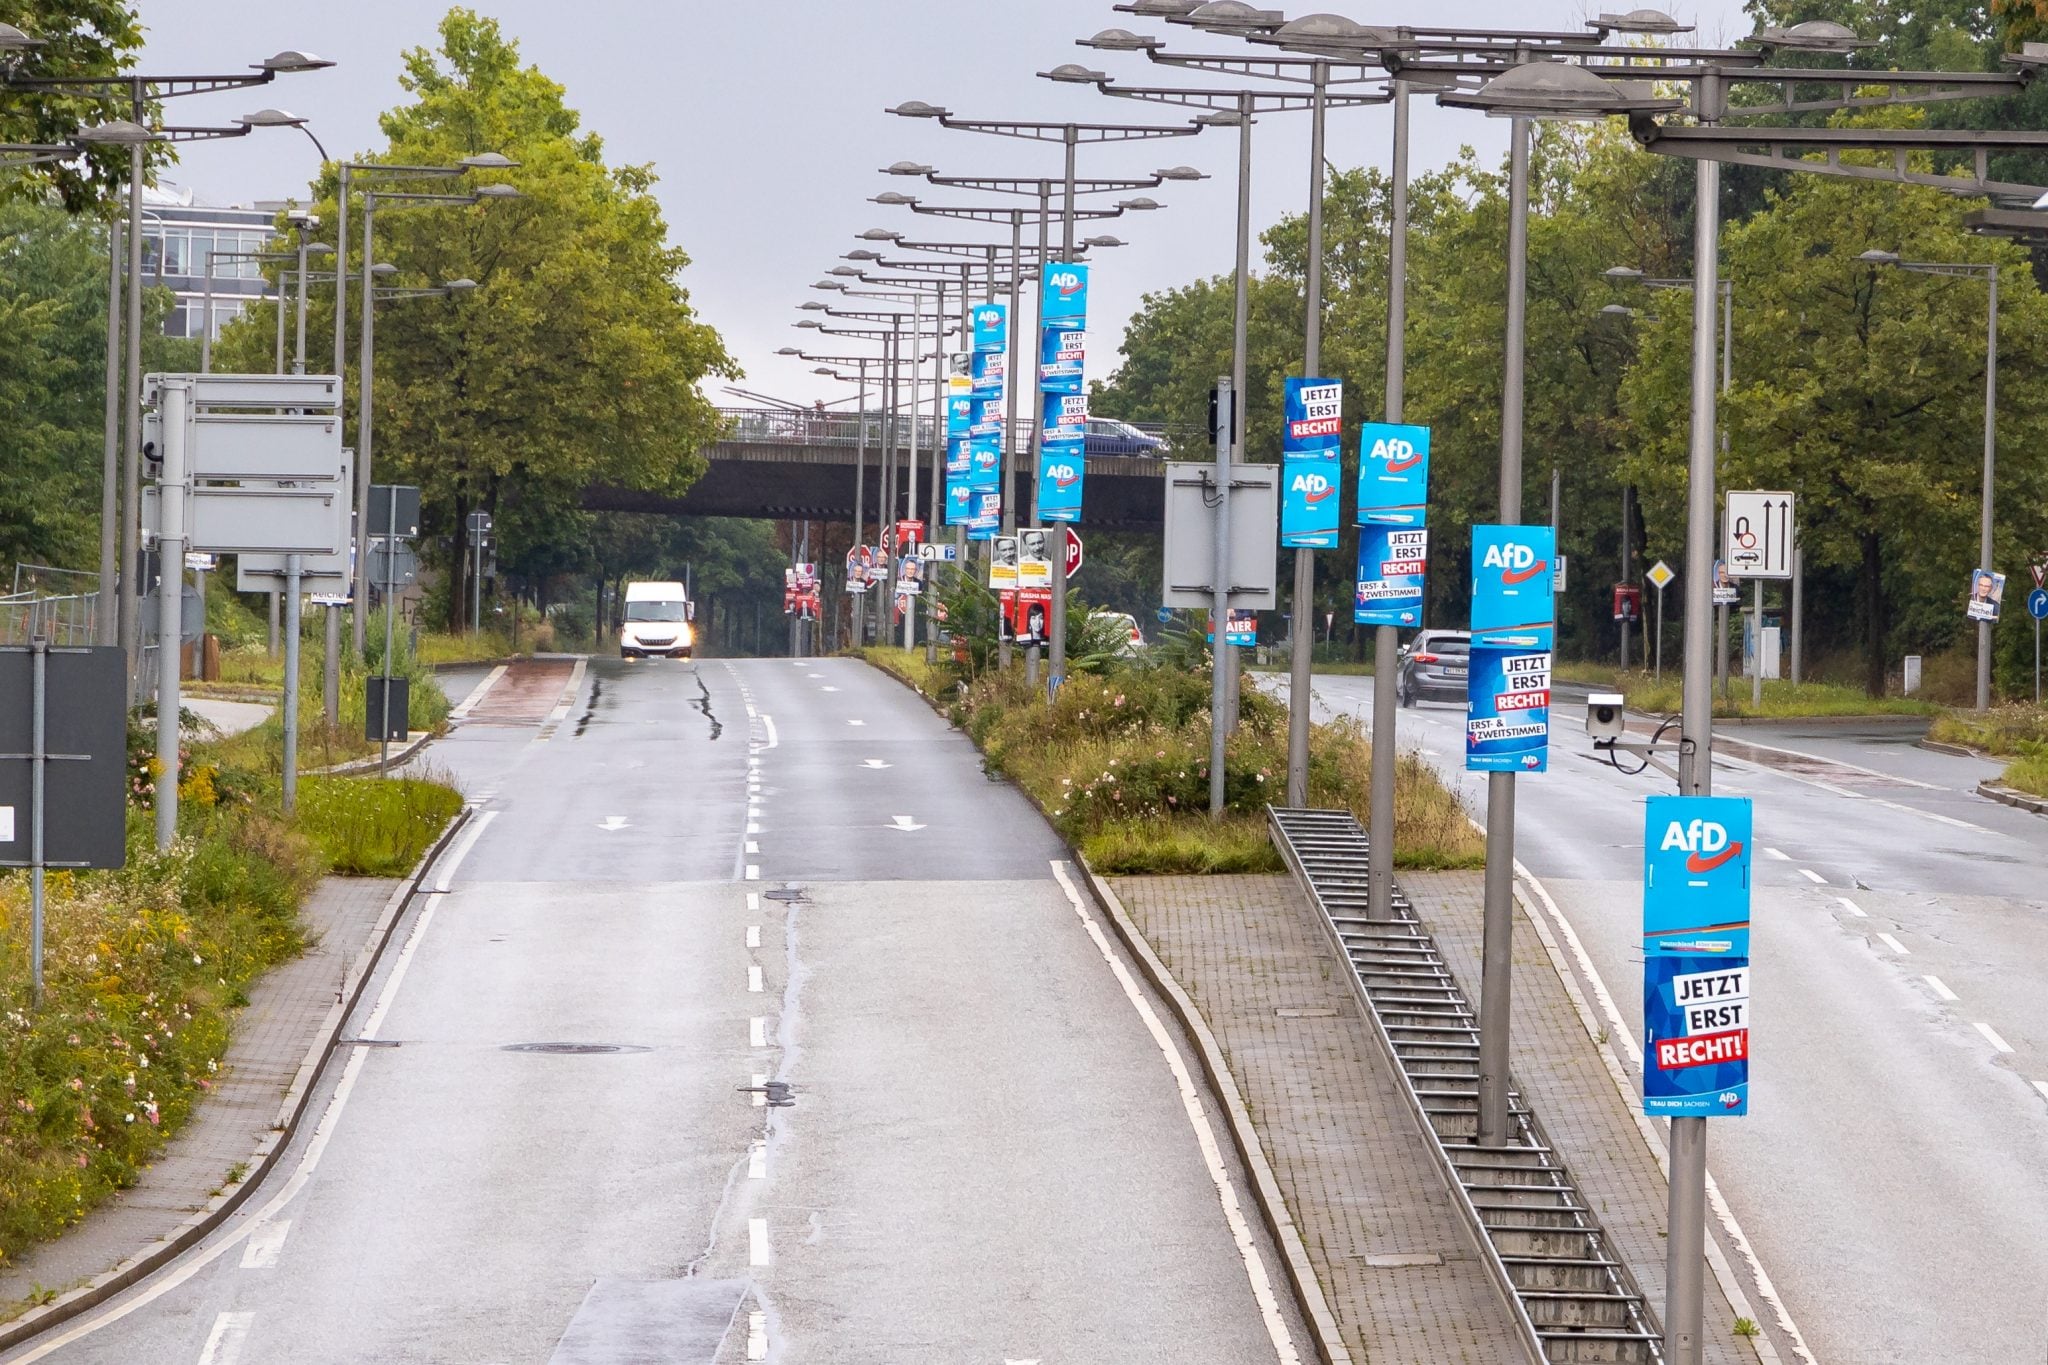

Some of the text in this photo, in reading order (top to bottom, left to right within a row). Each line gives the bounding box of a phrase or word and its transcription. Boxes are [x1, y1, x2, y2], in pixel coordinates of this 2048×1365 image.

[1050, 273, 1077, 287] AfD
[978, 311, 999, 322] AfD
[1063, 333, 1083, 341] JETZT
[1303, 388, 1338, 401] JETZT
[952, 400, 970, 410] AfD
[1063, 397, 1085, 406] JETZT
[1066, 407, 1084, 415] ERST
[1309, 404, 1338, 417] ERST
[1292, 420, 1338, 436] RECHT!
[1369, 438, 1414, 460] AfD
[974, 451, 995, 462] AfD
[1046, 464, 1074, 480] AfD
[1291, 473, 1328, 492] AfD
[951, 486, 970, 497] AfD
[1391, 532, 1424, 545] JETZT
[1396, 546, 1424, 559] ERST
[1482, 542, 1535, 568] AfD
[1382, 562, 1421, 575] RECHT!
[1381, 581, 1388, 590] &
[1365, 587, 1420, 600] ZWEITSTIMME!
[1507, 656, 1546, 672] JETZT
[1512, 674, 1546, 690] ERST
[1496, 692, 1545, 710] RECHT!
[1470, 718, 1504, 730] ERST- &
[1476, 725, 1545, 740] ZWEITSTIMME!
[1521, 755, 1538, 764] AfD
[1660, 818, 1728, 852] AfD
[1679, 973, 1742, 1001] JETZT
[1690, 1005, 1743, 1030] ERST
[1660, 1035, 1743, 1066] RECHT!
[1718, 1092, 1738, 1103] AfD
